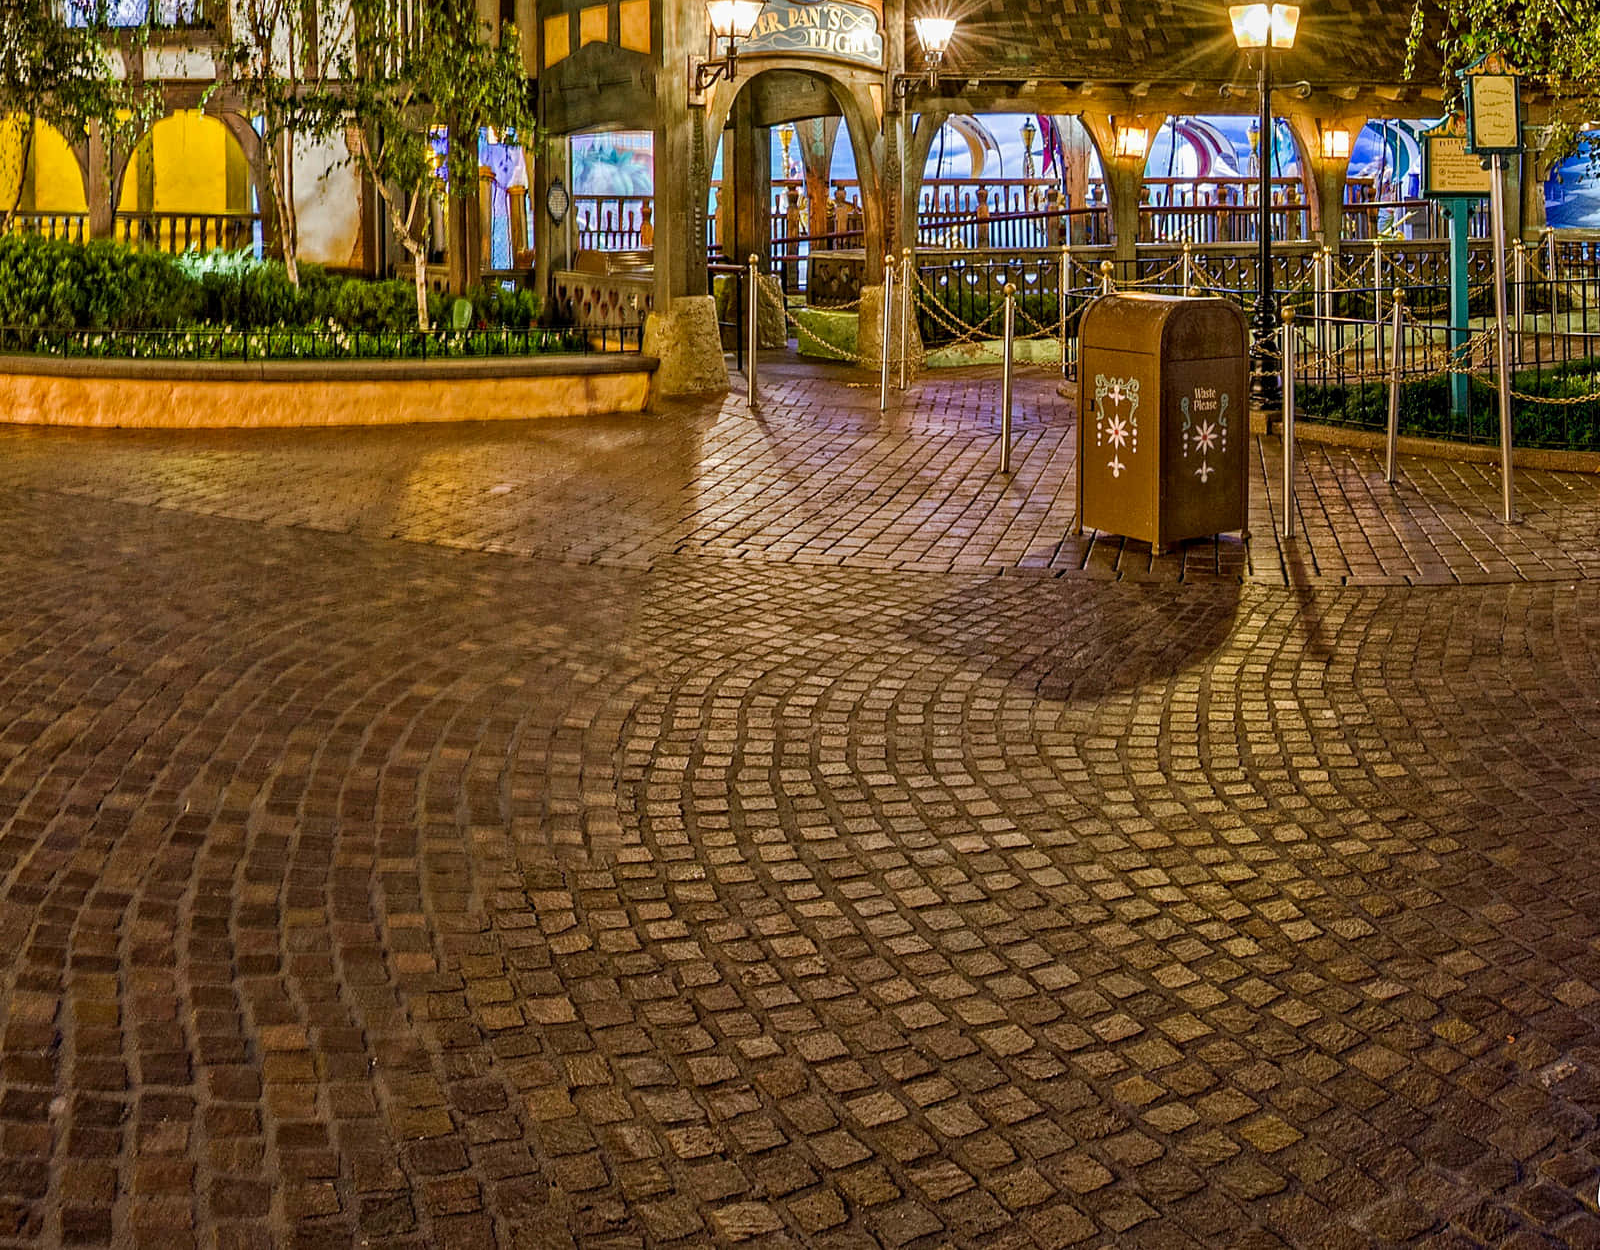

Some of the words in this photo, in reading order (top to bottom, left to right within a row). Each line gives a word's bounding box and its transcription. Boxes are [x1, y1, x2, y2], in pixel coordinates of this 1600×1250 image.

[788, 6, 841, 30] PAN'S
[1194, 387, 1217, 399] Waste
[1193, 399, 1218, 411] Please
